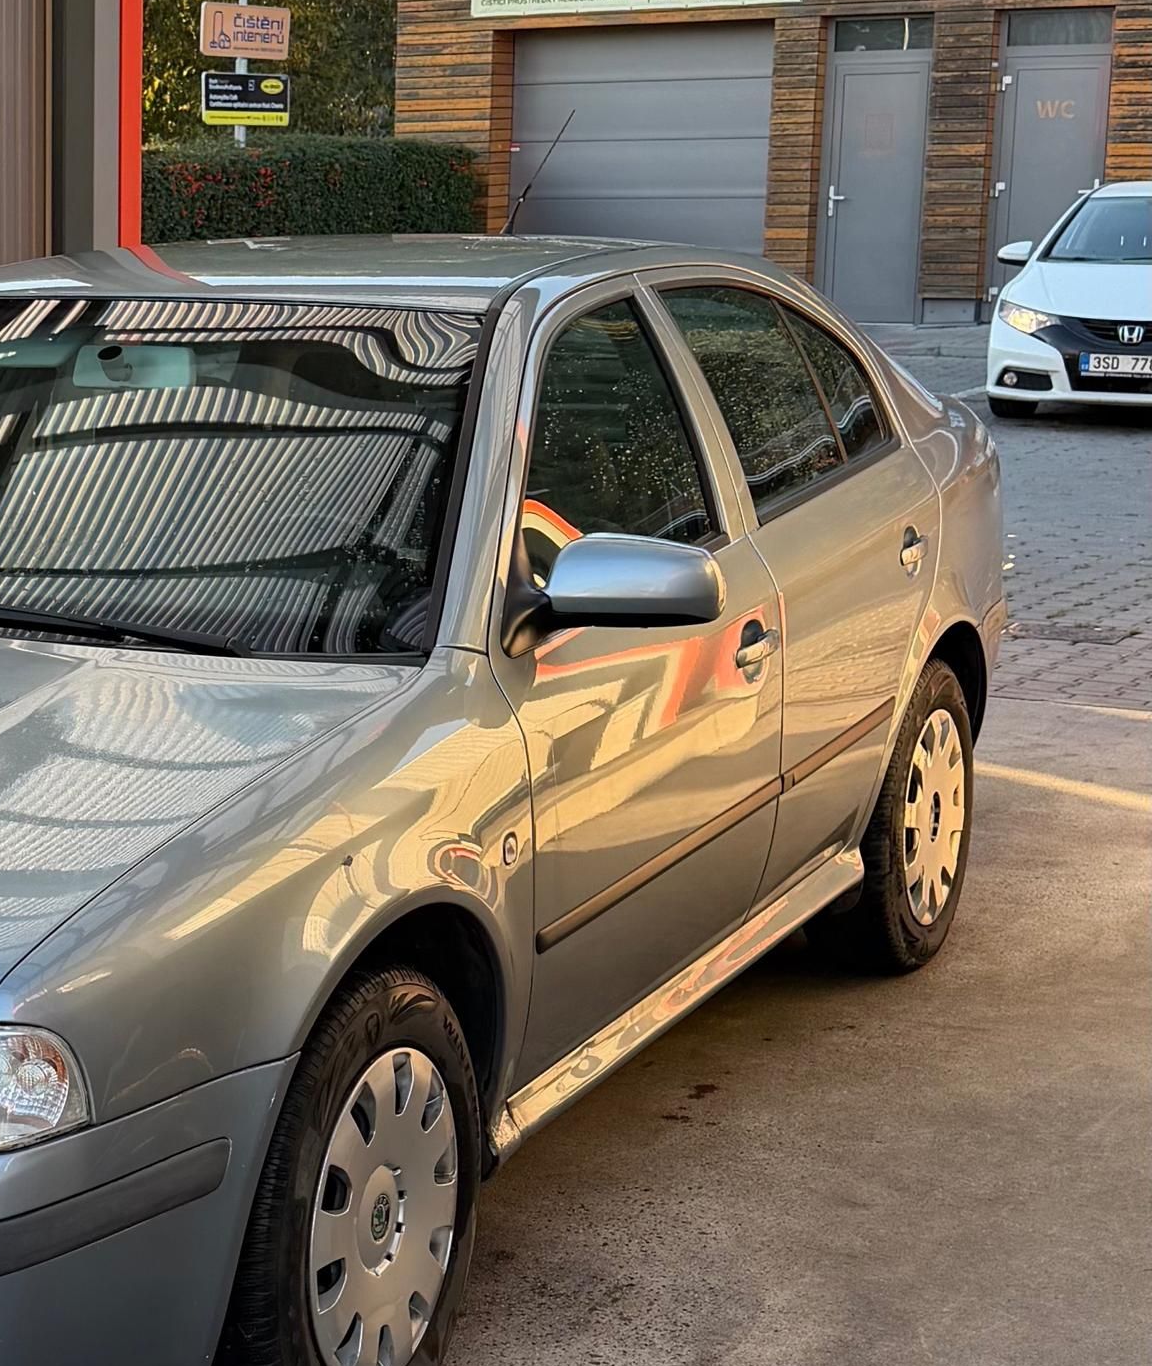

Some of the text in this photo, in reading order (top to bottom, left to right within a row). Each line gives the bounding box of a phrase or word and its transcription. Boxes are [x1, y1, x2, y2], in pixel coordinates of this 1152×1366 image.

[234, 13, 284, 30] Čištění
[1037, 100, 1075, 119] WC
[1093, 356, 1120, 370] 3SD
